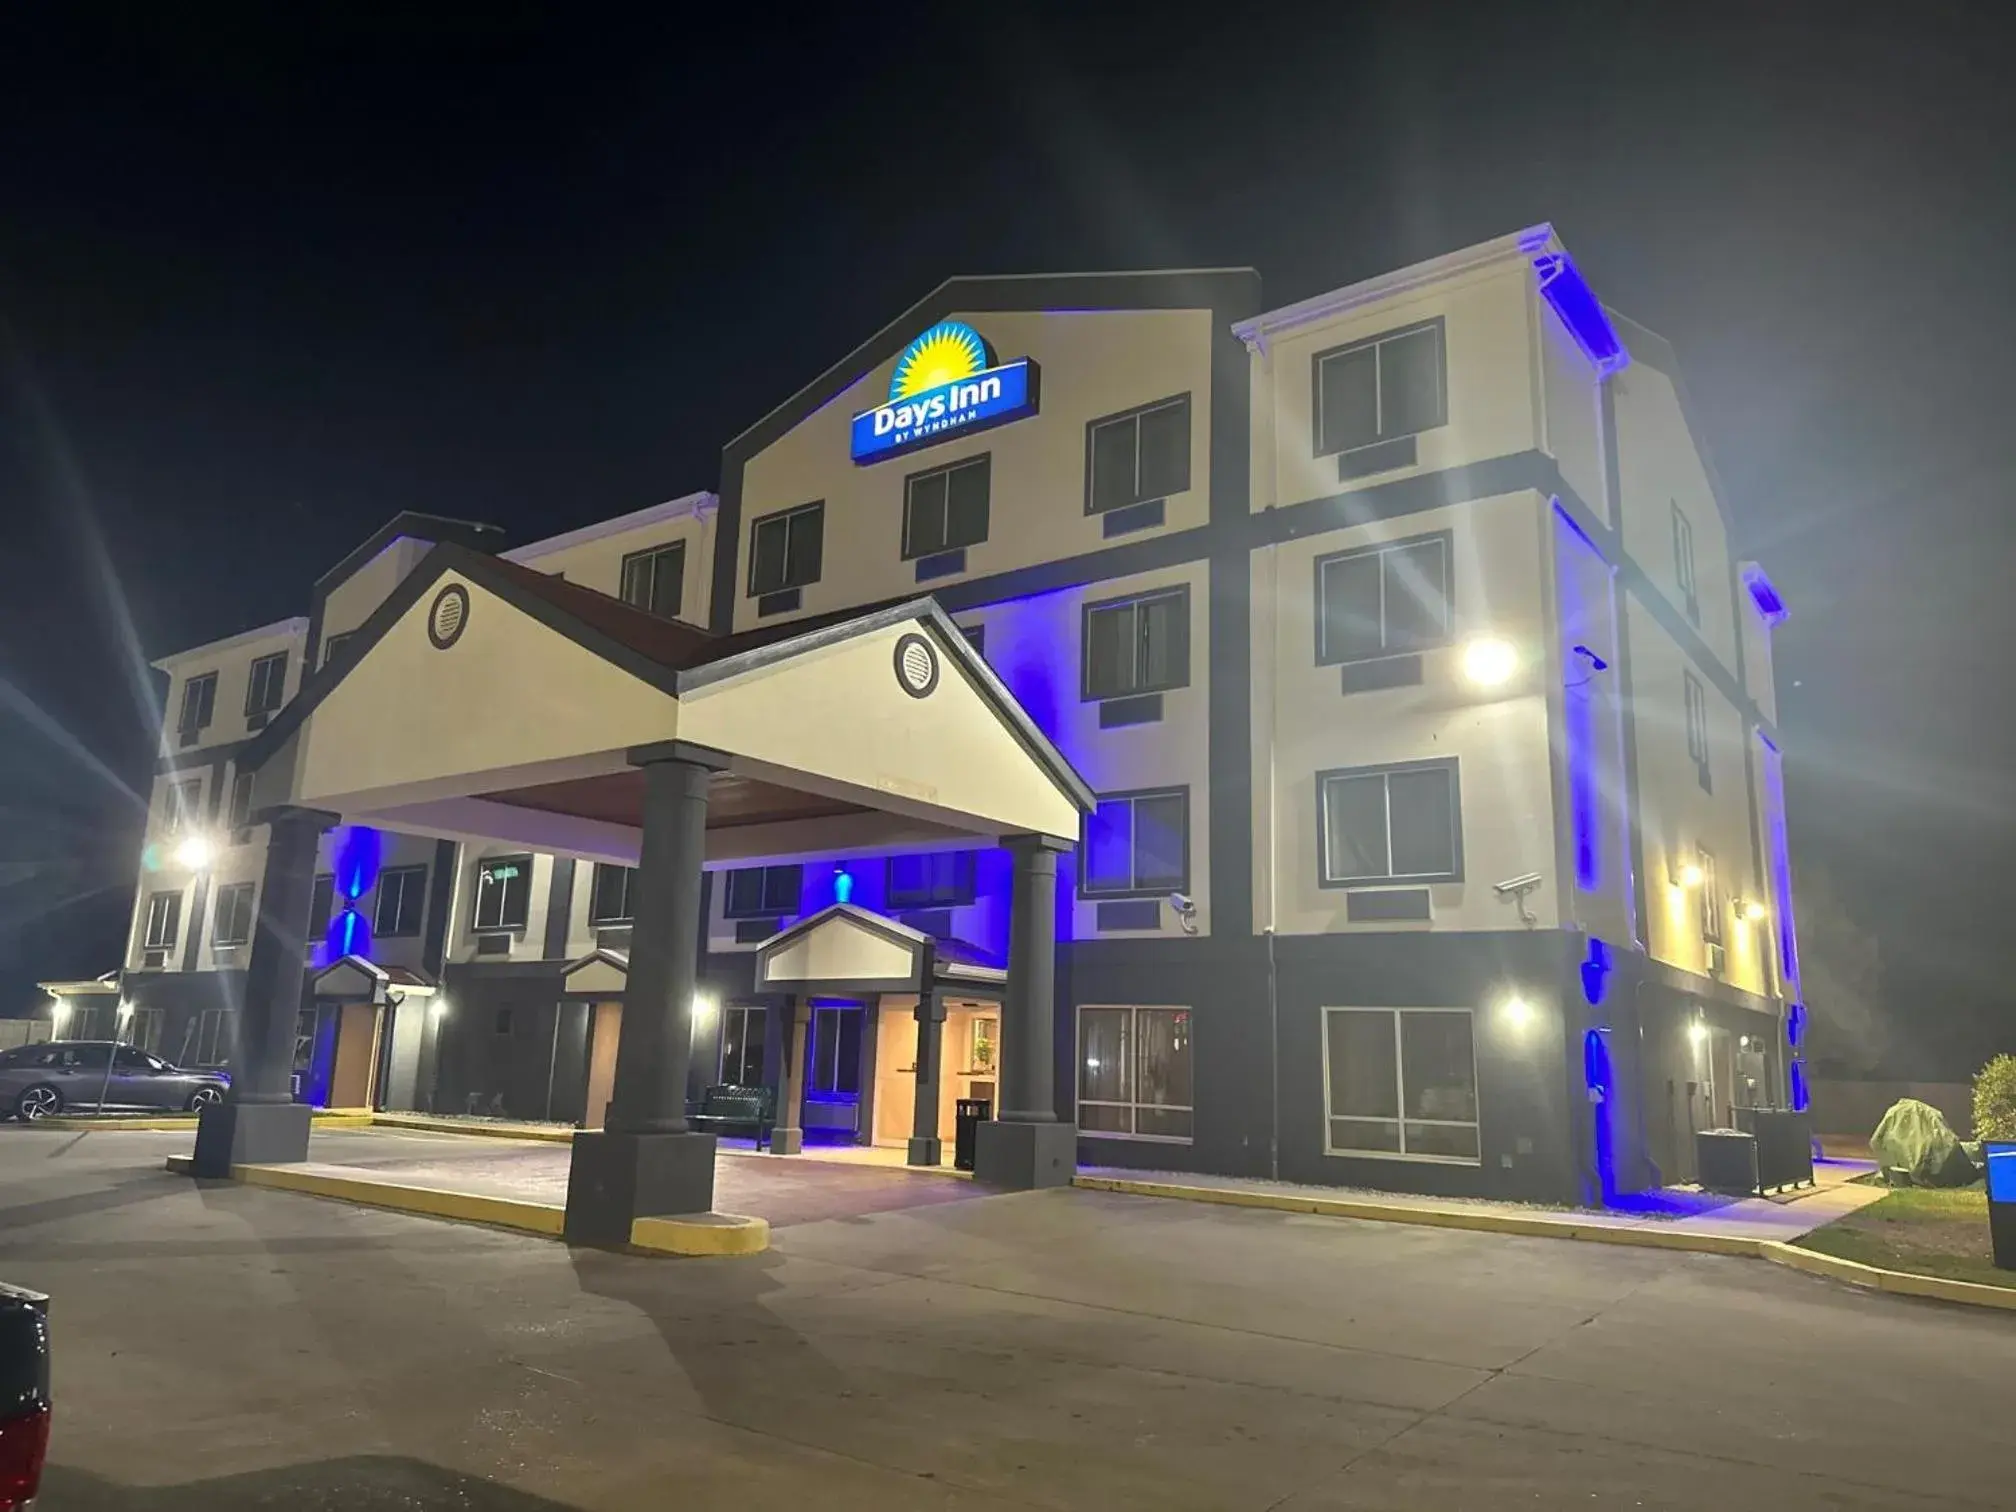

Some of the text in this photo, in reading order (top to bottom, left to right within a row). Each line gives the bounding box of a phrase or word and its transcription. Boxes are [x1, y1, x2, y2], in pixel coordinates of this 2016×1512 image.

[874, 377, 1000, 436] Days Inn
[895, 410, 977, 443] BY WYNDHAM
